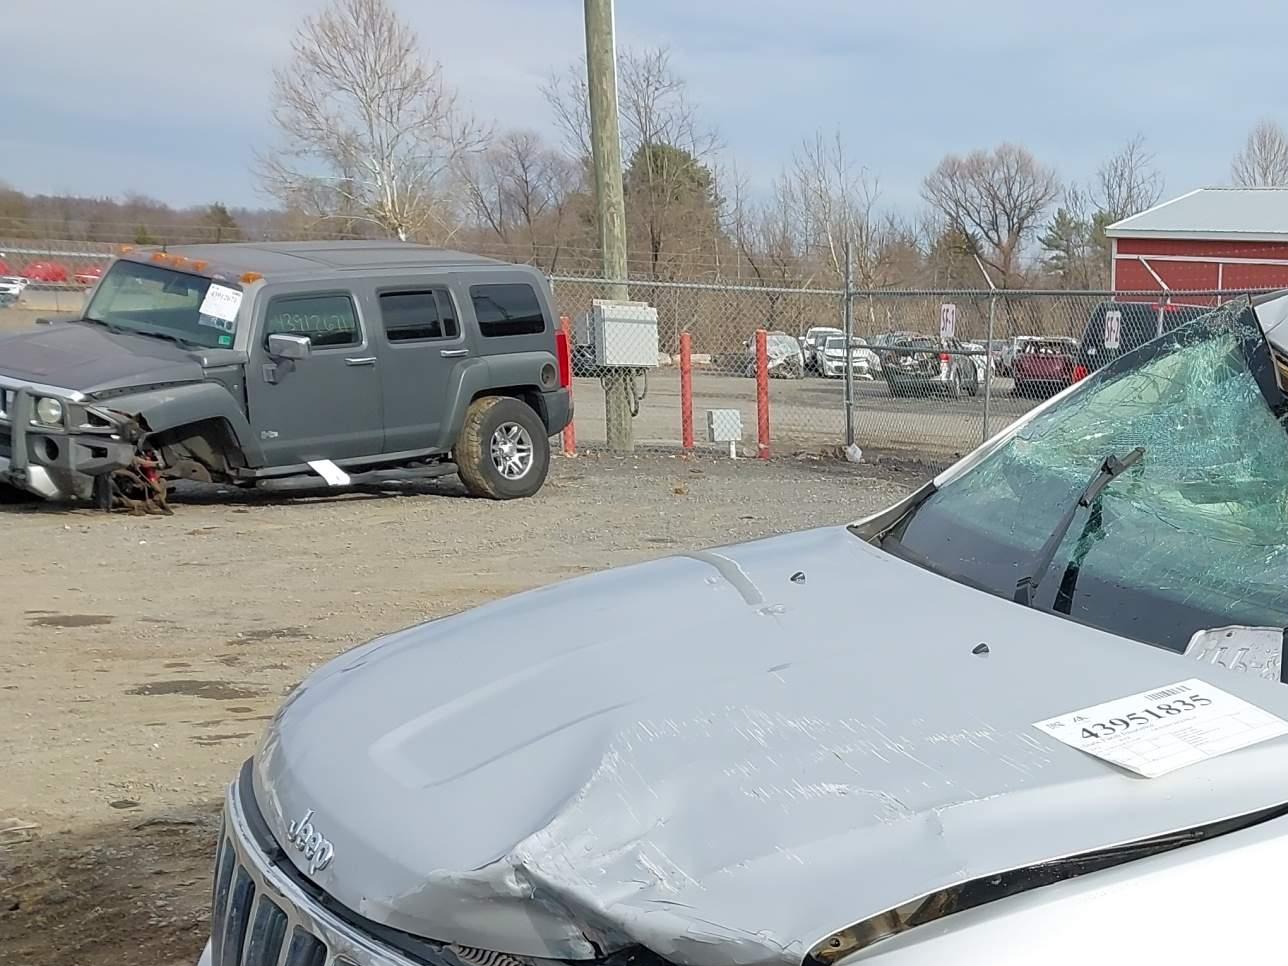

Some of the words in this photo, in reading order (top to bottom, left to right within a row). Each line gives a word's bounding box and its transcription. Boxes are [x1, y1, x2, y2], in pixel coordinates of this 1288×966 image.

[1106, 316, 1119, 342] SF-2
[1081, 694, 1212, 739] 43951835
[287, 808, 335, 875] Jeep
